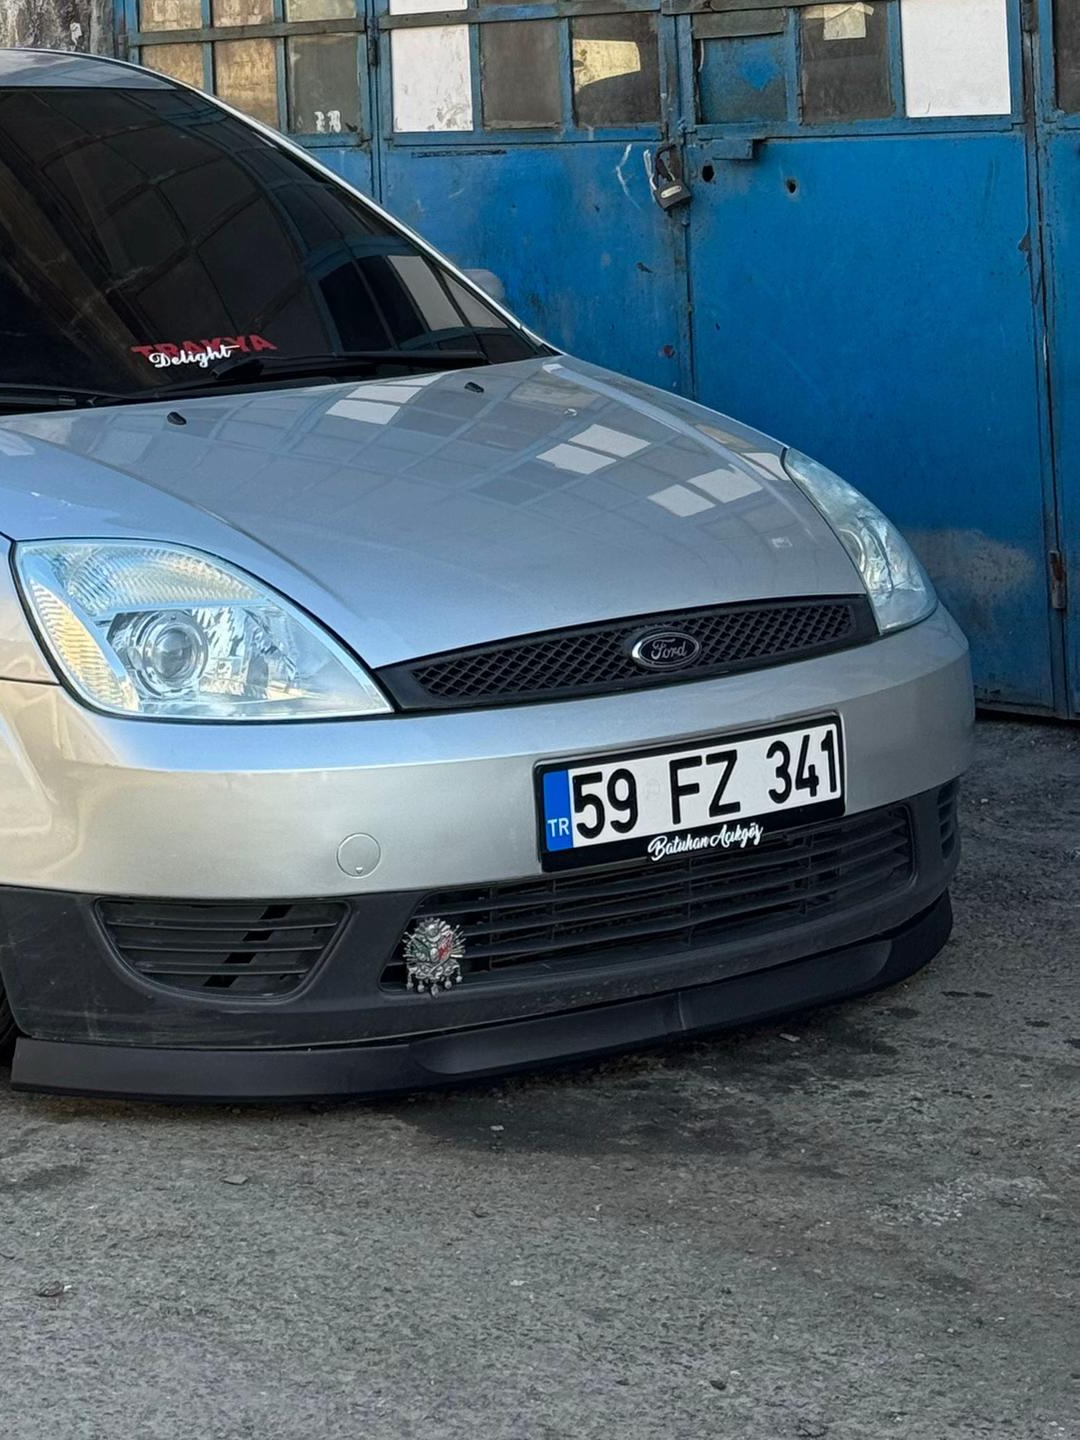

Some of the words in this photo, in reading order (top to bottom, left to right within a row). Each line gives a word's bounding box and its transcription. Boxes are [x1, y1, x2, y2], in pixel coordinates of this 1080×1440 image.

[149, 344, 240, 368] Delight
[651, 638, 688, 660] Ford
[547, 818, 570, 838] TR
[572, 768, 638, 840] 59
[669, 749, 741, 825] FZ
[766, 729, 838, 805] 341
[647, 834, 709, 861] Batuhan
